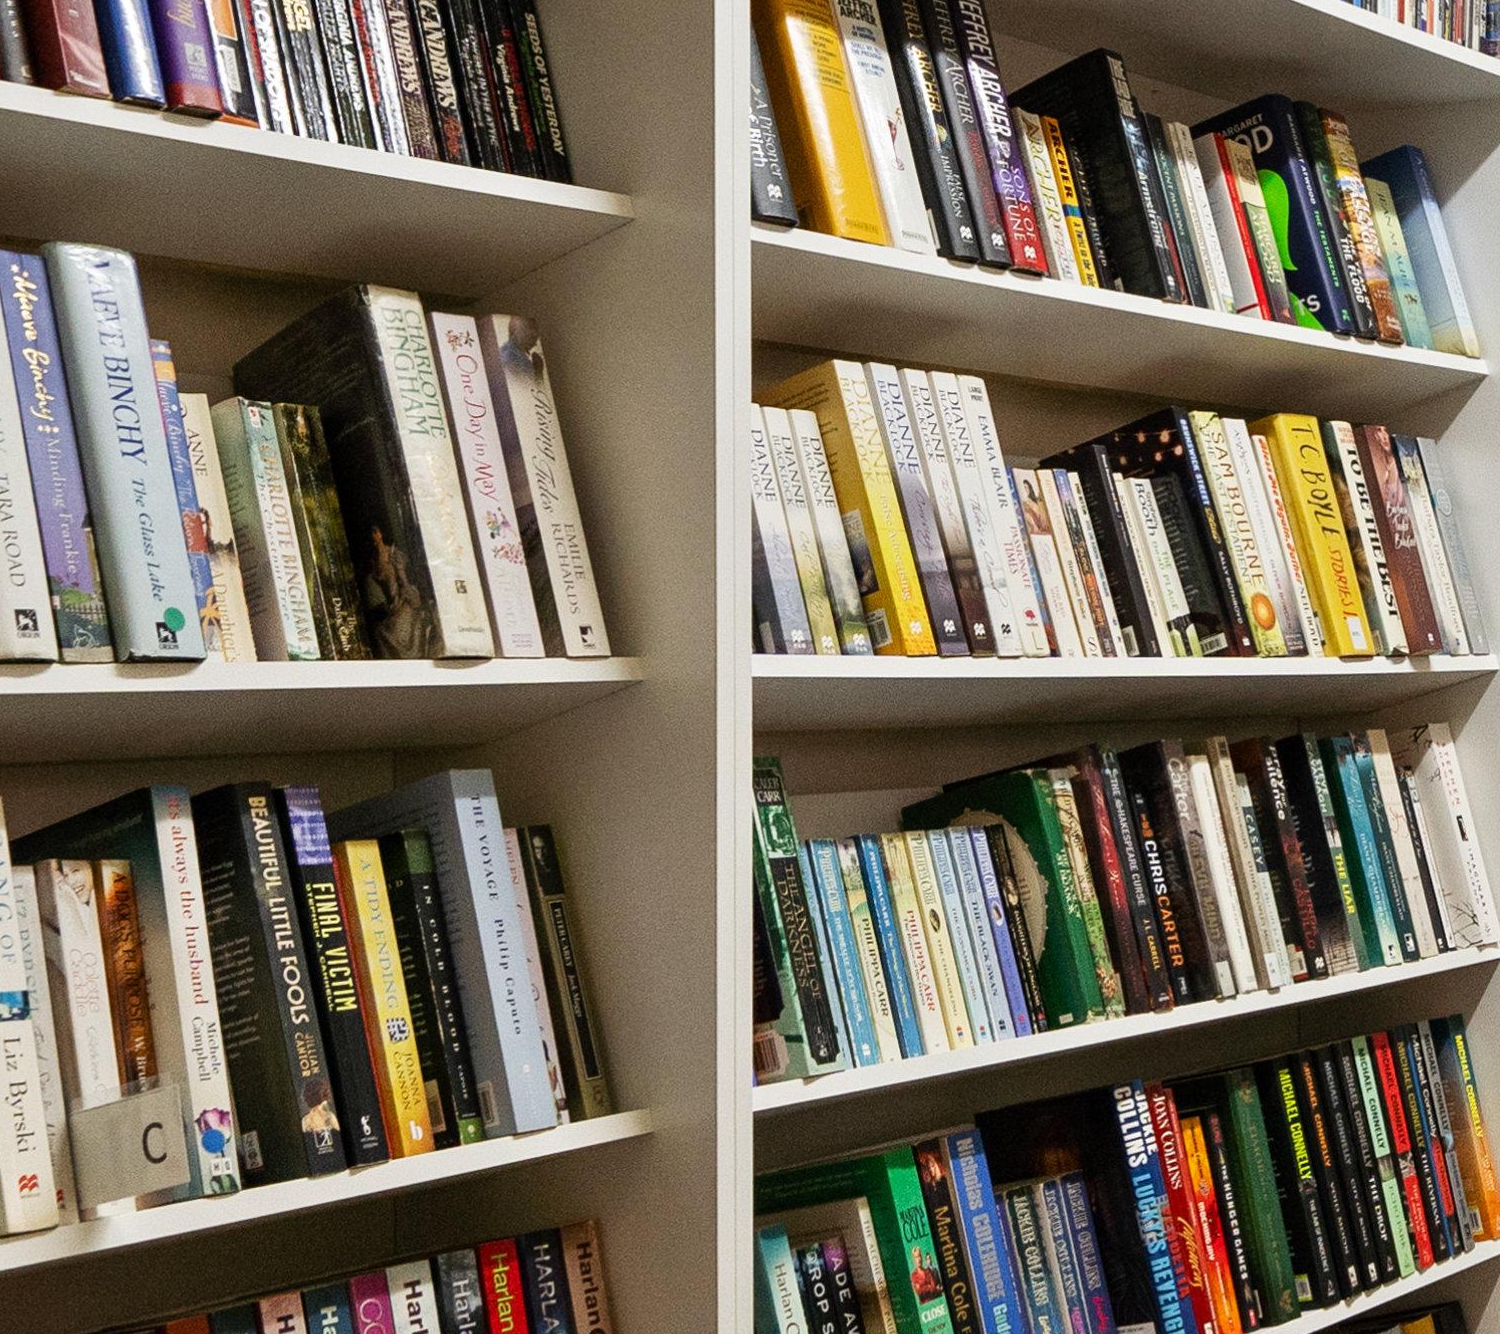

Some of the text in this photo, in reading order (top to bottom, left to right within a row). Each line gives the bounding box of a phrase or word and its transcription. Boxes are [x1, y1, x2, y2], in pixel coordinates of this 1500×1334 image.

[977, 68, 1012, 140] ARCHER
[379, 305, 432, 438] BINGHAM
[400, 306, 450, 442] CHARLOTTE
[0, 528, 29, 589] ROAD
[1210, 430, 1265, 587] SAM BOURNE
[245, 793, 311, 1028] BEAUTIFUL LITTLE FOOLS
[311, 881, 359, 1015] FINAL VICTIM
[1, 1036, 38, 1157] Liz Byrski
[140, 1121, 168, 1165] C
[488, 1252, 516, 1334] Harlan
